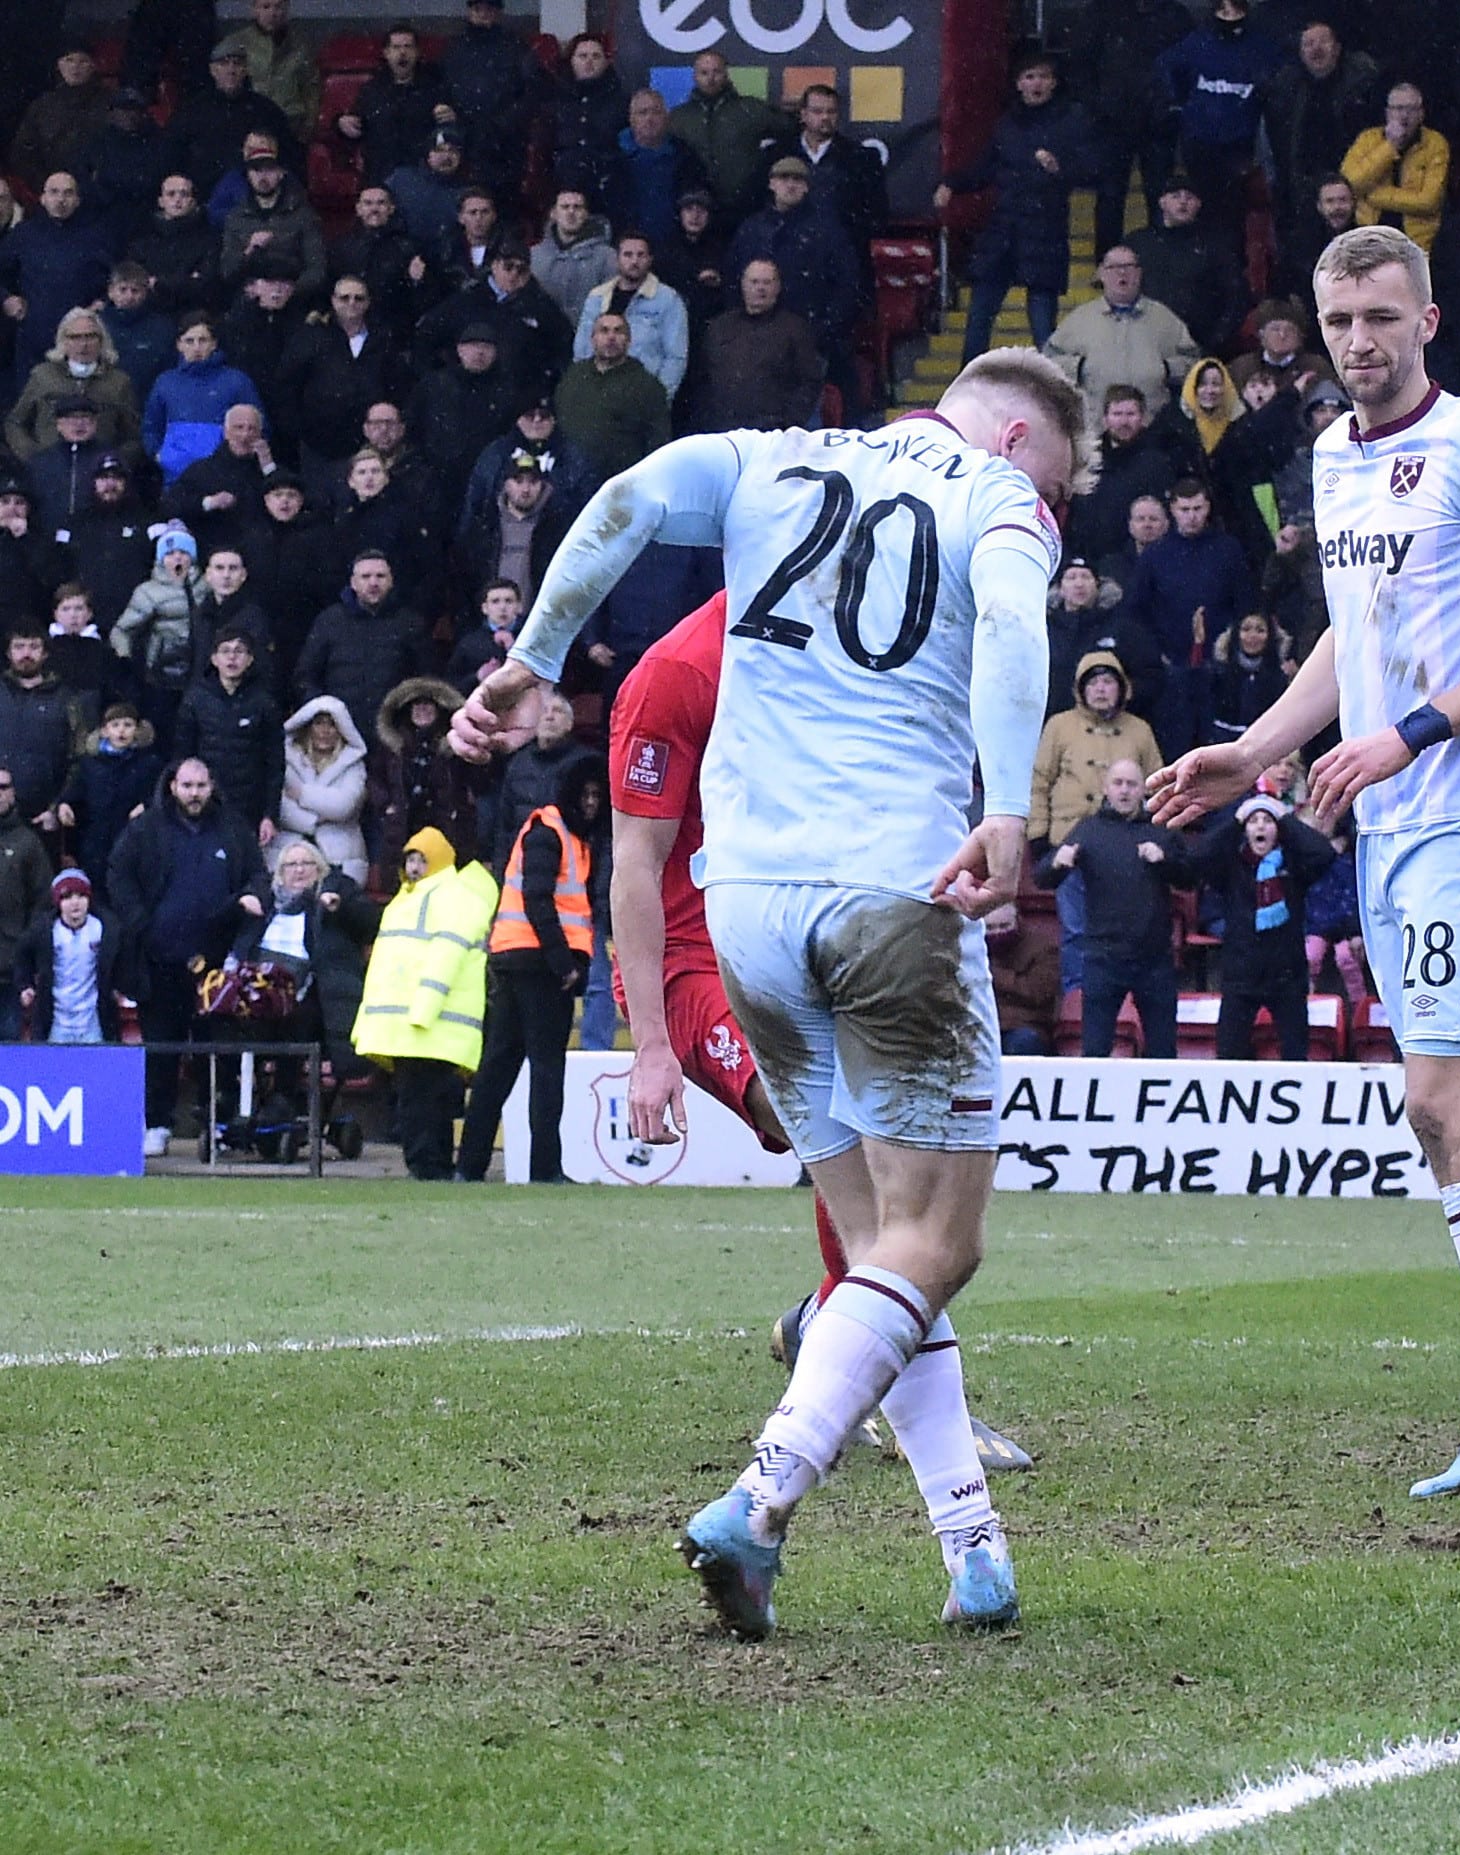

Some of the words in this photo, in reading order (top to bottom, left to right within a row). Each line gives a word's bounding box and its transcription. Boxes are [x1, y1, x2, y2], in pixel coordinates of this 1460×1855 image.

[727, 465, 940, 673] 20
[1402, 921, 1456, 988] 28
[1000, 1077, 1115, 1122] ALL
[1135, 1079, 1301, 1124] FANS
[1089, 1145, 1220, 1193] THE
